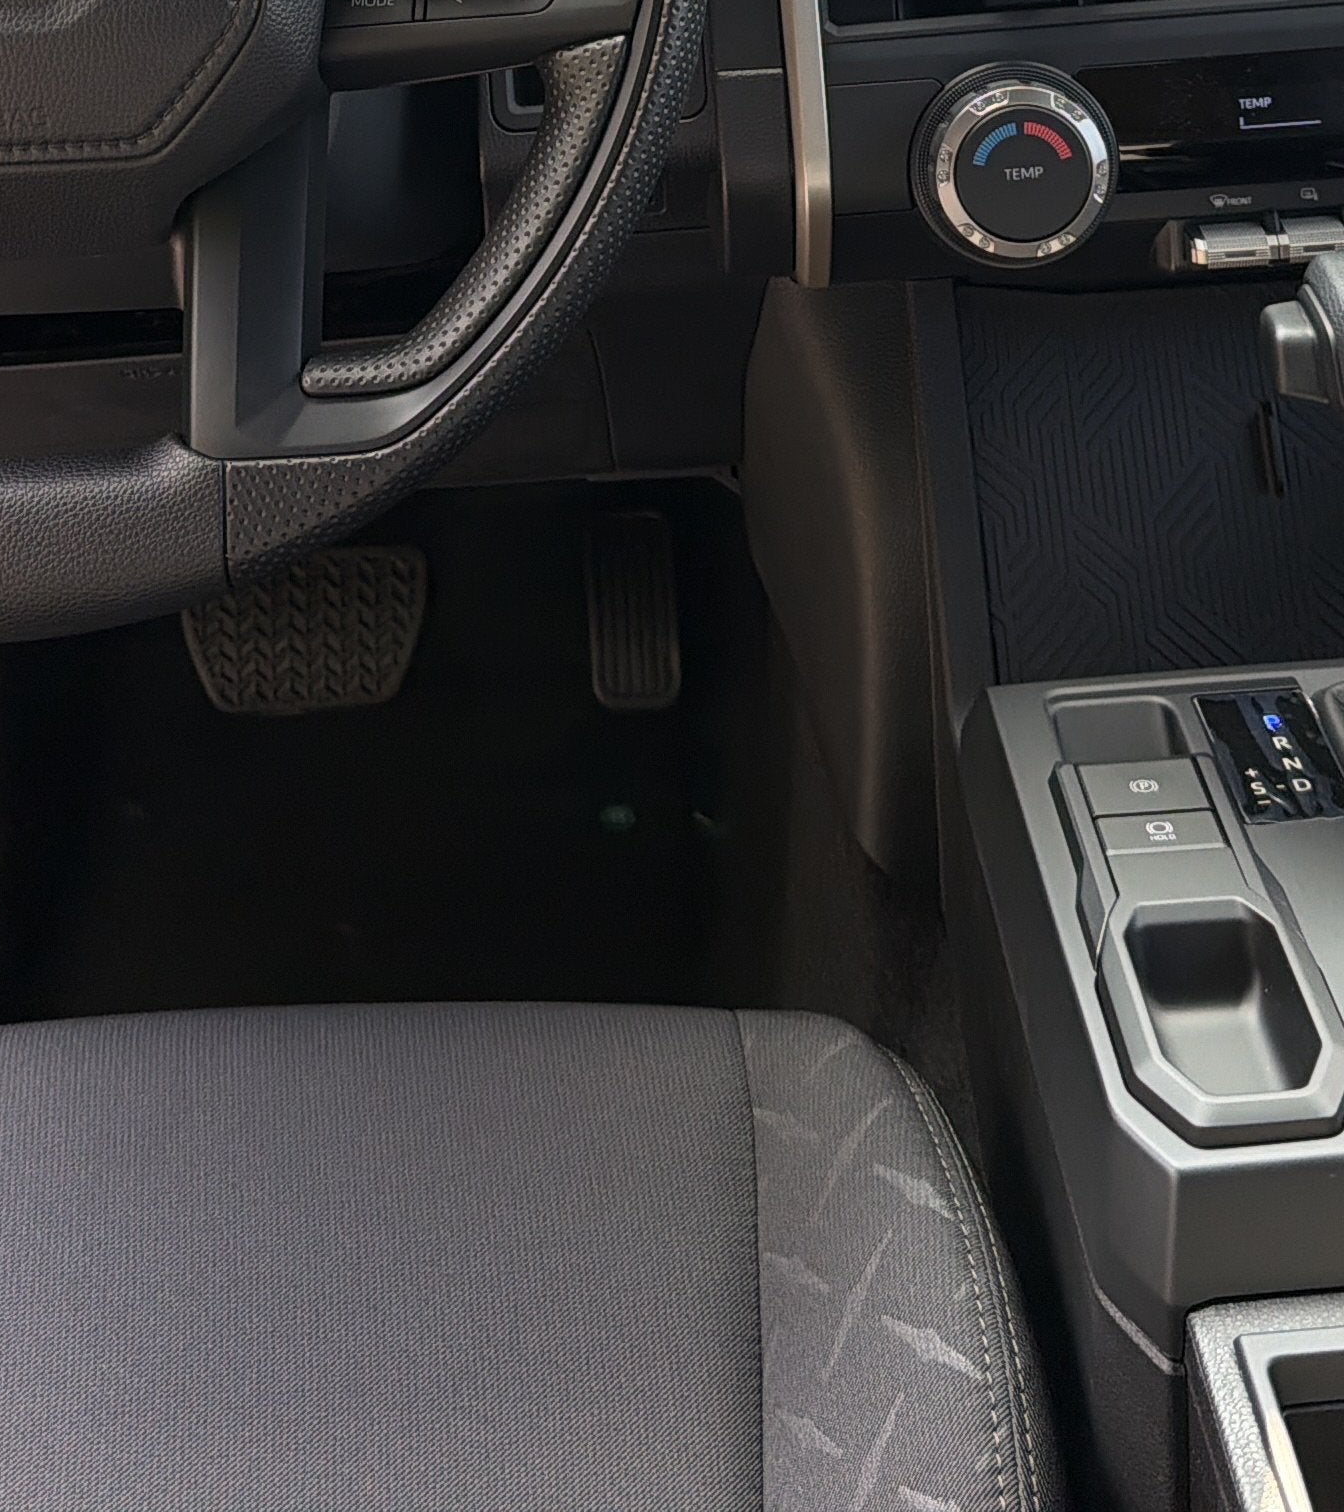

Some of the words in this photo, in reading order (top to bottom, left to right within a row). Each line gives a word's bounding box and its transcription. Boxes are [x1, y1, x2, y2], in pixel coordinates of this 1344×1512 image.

[1238, 96, 1273, 111] TEMP
[1003, 166, 1044, 181] TEMP
[1226, 196, 1253, 207] FRONT
[1263, 714, 1282, 733] P
[1272, 735, 1293, 752] R
[1282, 756, 1304, 771] N
[1250, 781, 1267, 796] S
[1291, 778, 1313, 793] D
[1149, 833, 1177, 841] HOLD
